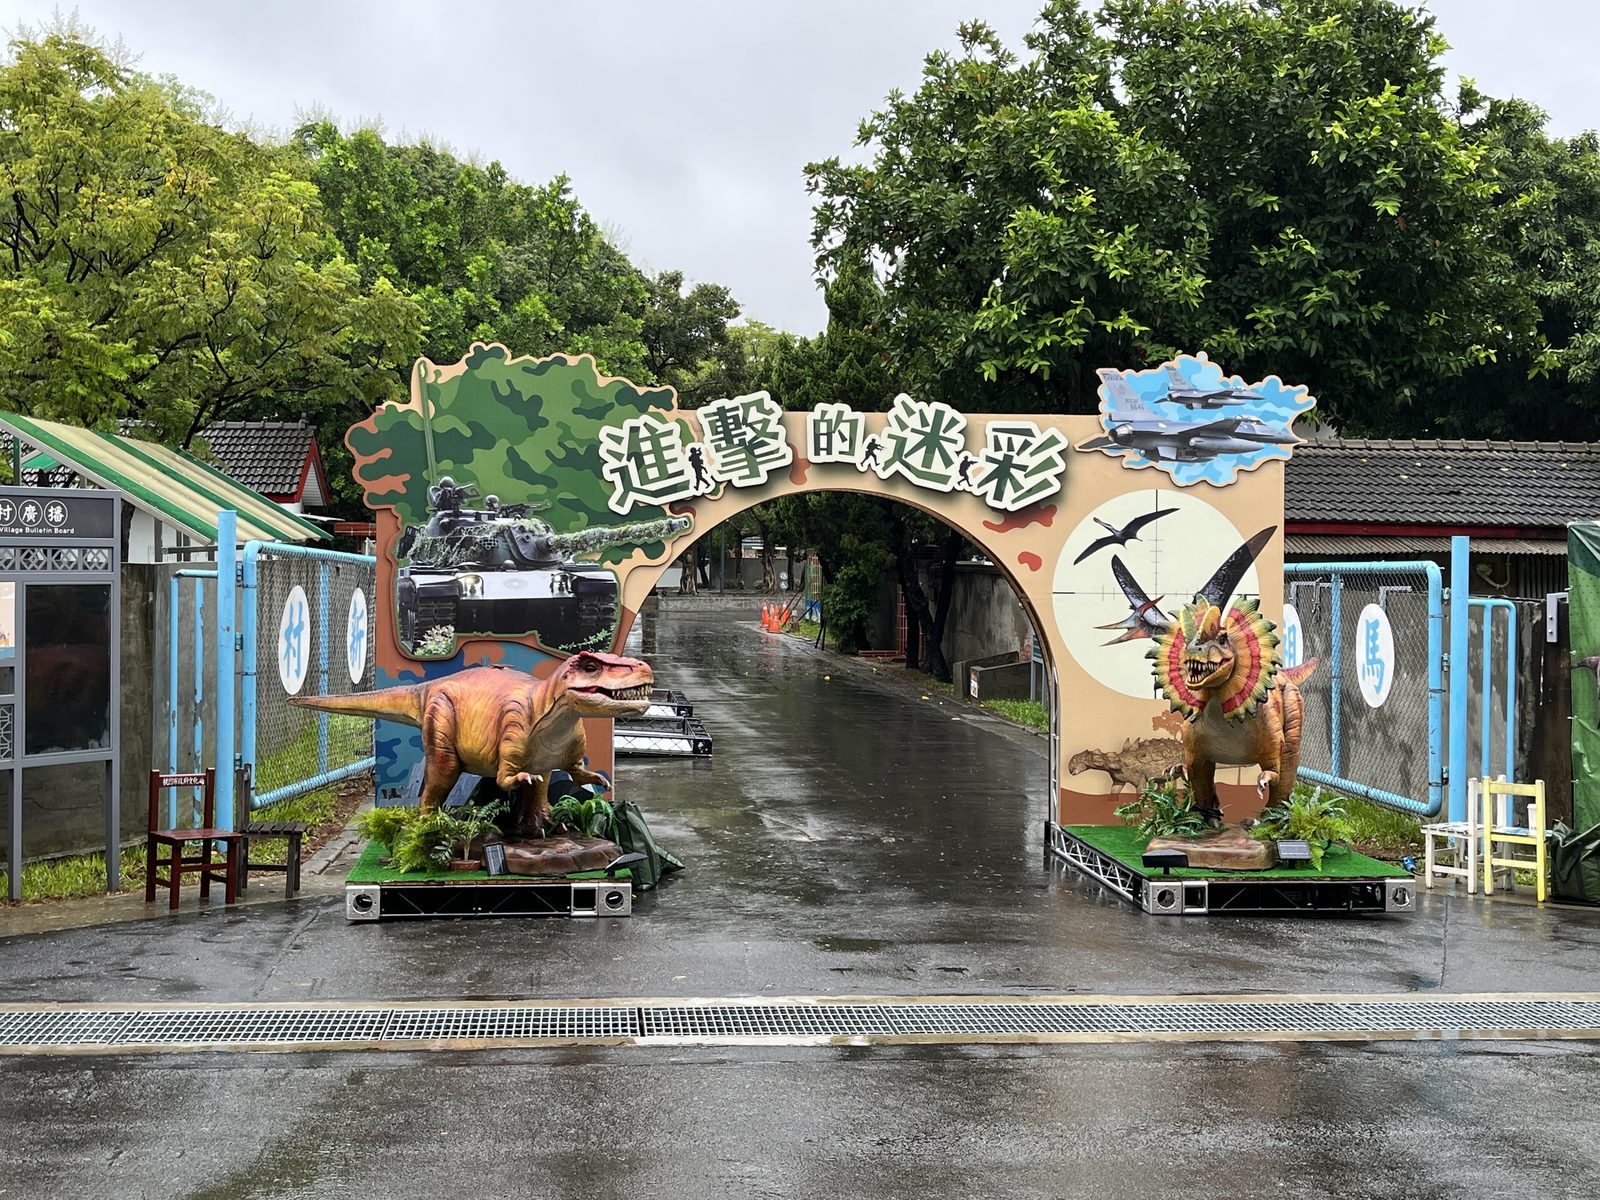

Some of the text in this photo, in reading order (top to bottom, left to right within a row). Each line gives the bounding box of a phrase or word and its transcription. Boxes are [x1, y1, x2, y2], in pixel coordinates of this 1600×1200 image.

[602, 392, 1066, 512] 進擊的迷彩
[1361, 618, 1385, 694] 馬
